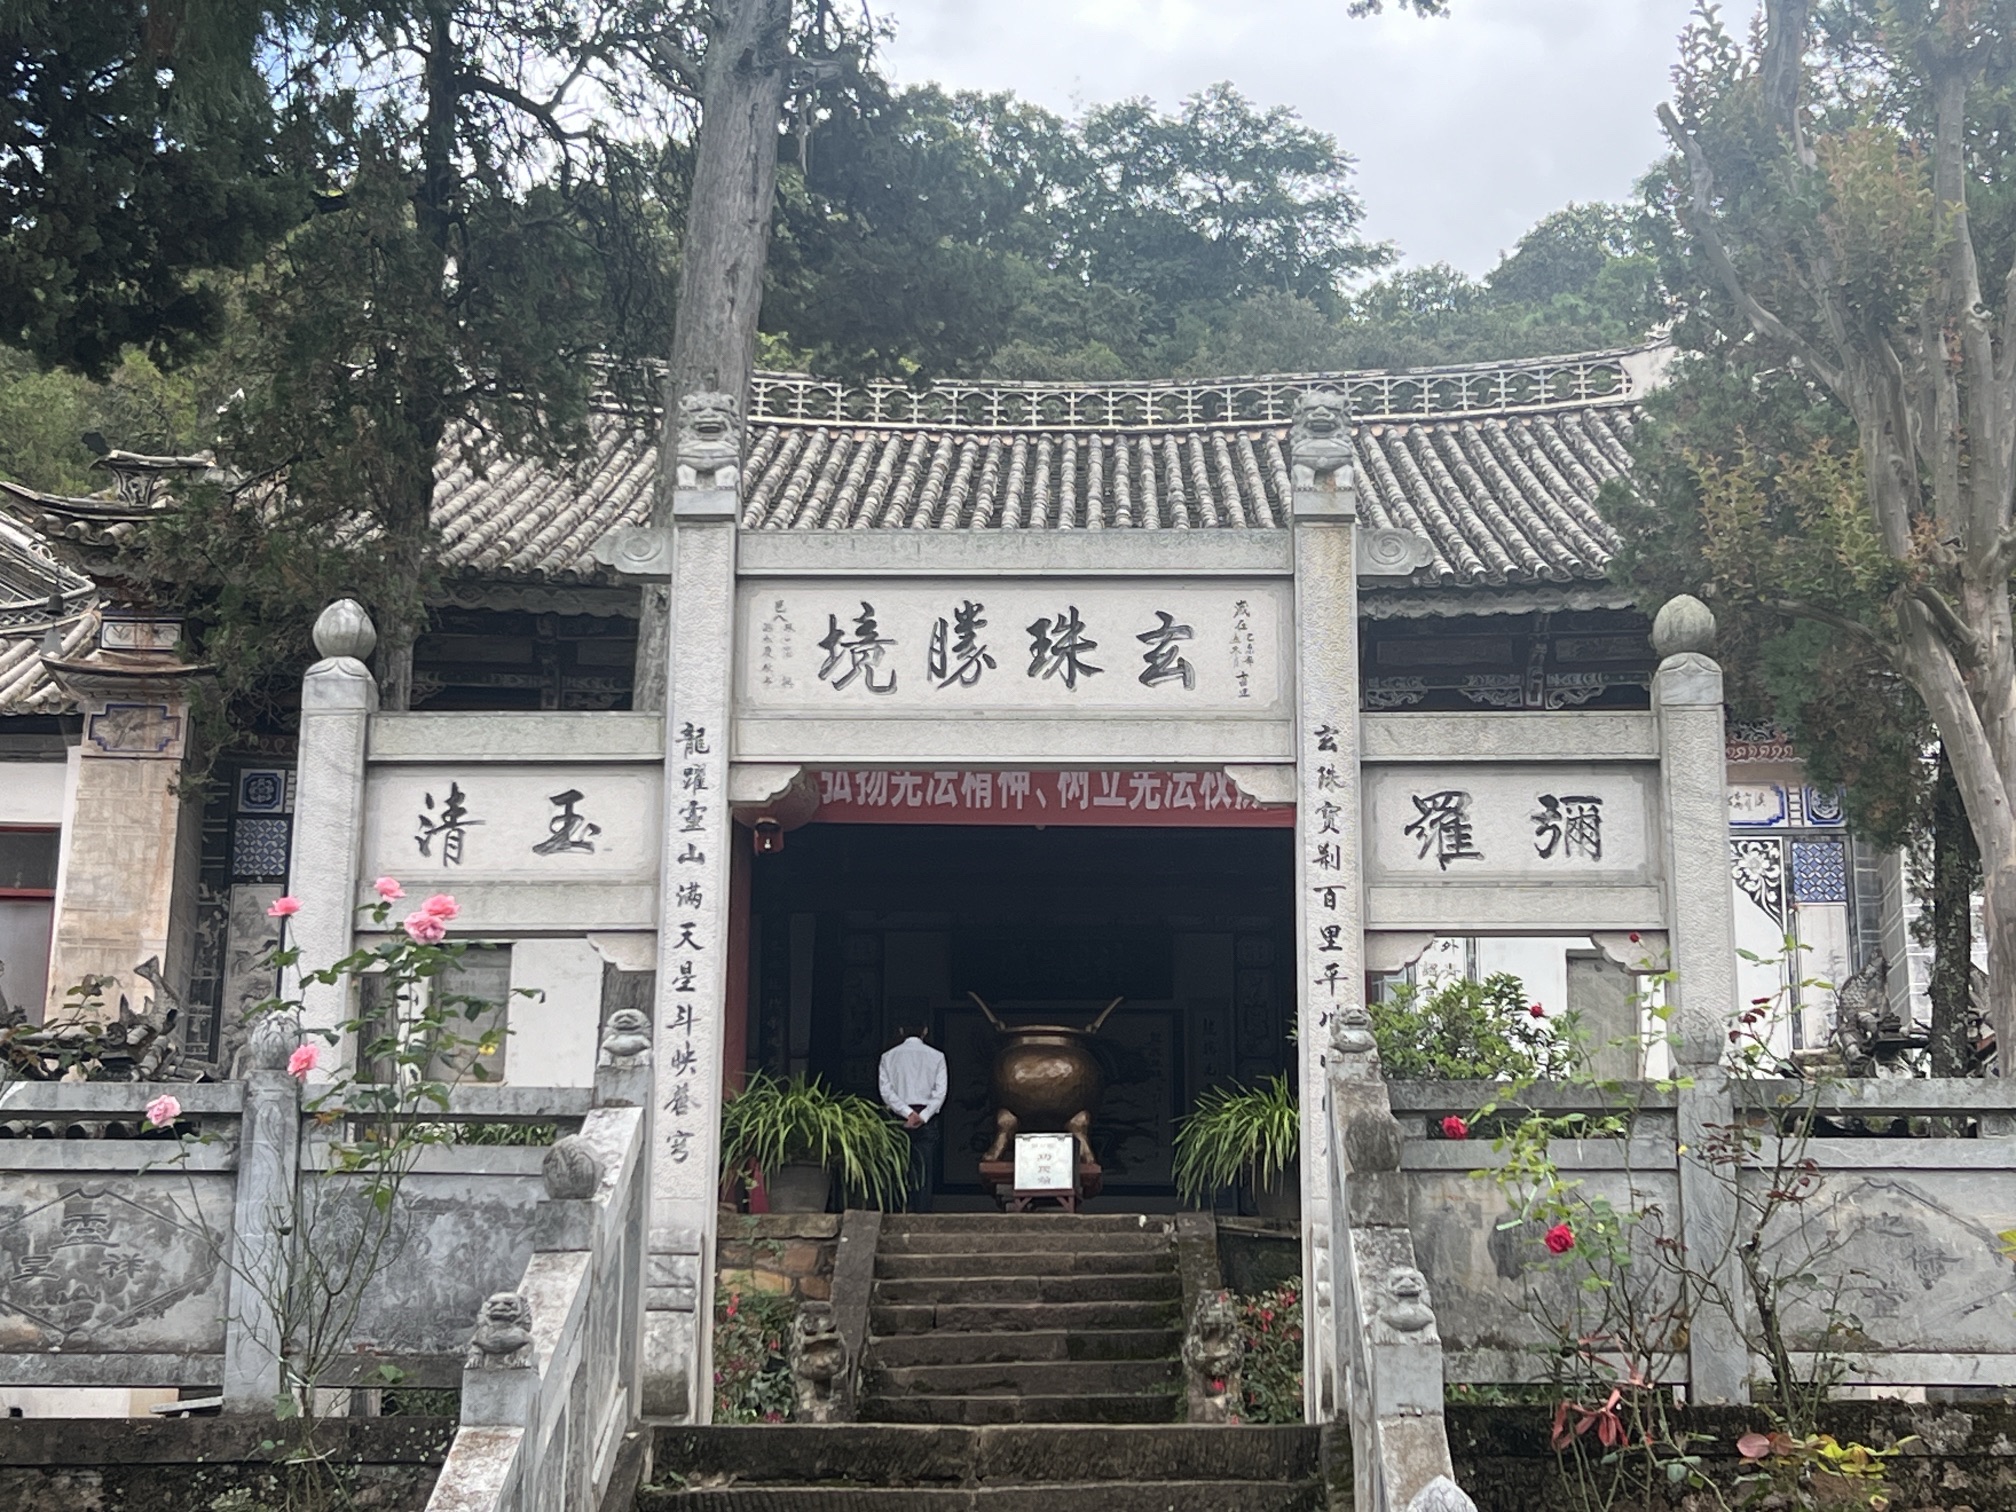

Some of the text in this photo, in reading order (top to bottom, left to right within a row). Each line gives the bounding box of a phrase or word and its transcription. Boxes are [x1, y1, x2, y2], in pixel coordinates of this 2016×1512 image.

[817, 599, 1195, 694] 玄珠勝境
[414, 781, 602, 867] 玉清
[821, 771, 1268, 811] 弘扬宪法精神、树立宪法权
